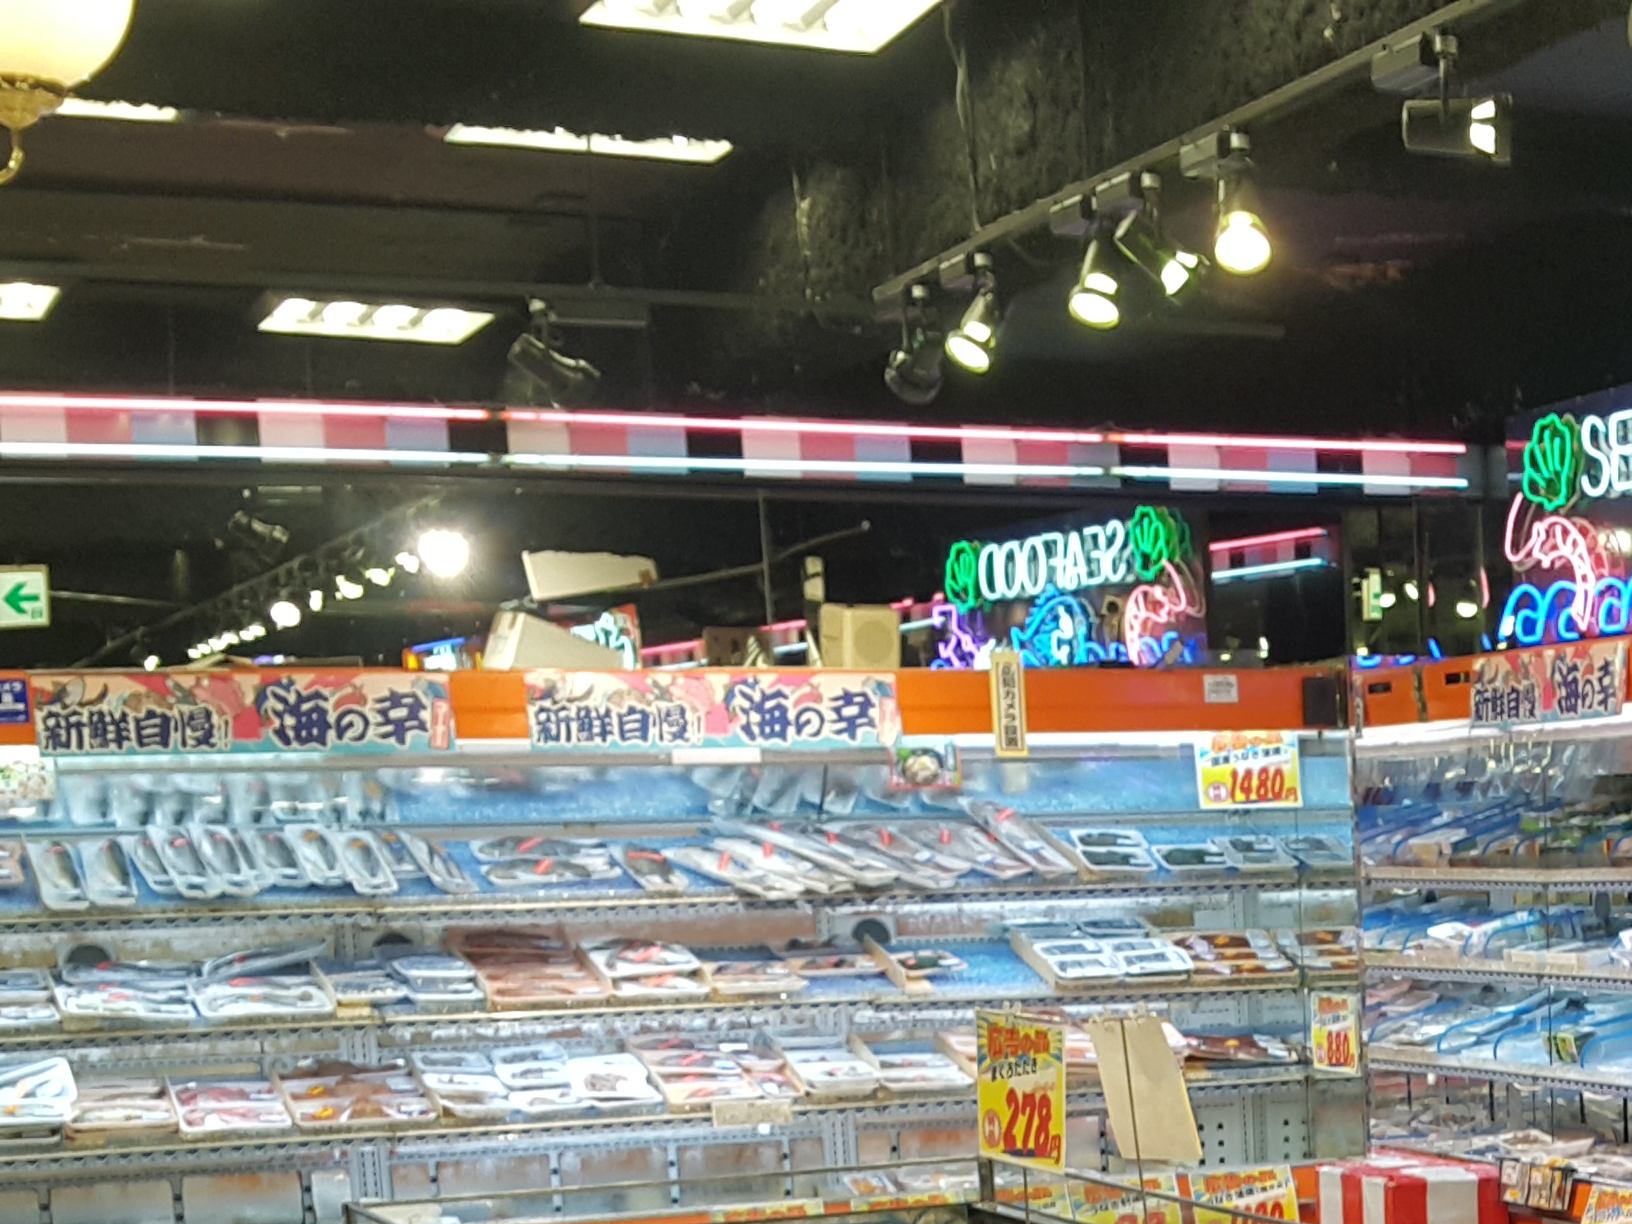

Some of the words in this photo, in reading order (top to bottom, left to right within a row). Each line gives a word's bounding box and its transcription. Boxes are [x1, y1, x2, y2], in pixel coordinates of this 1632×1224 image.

[273, 684, 429, 748] 海の幸
[738, 686, 879, 743] 海の幸
[1229, 766, 1298, 802] 1480円
[1003, 1087, 1061, 1165] 278円
